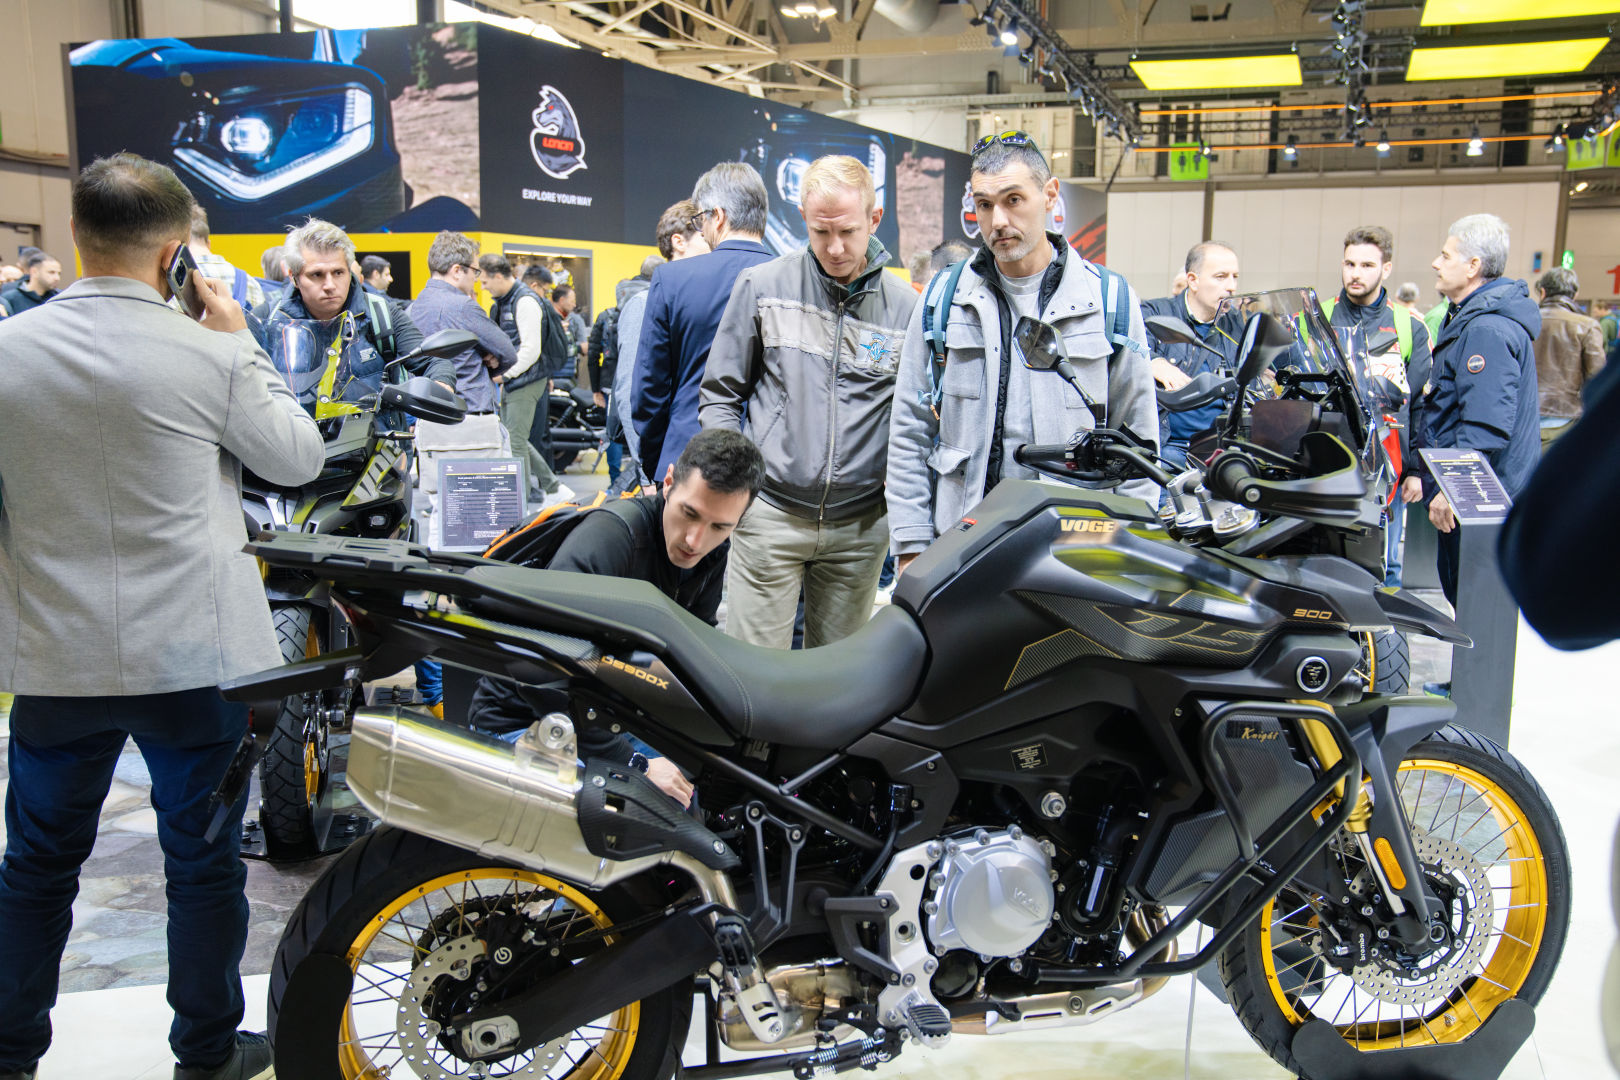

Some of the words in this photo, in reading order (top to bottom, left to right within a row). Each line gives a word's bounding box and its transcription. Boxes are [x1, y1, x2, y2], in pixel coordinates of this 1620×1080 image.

[522, 188, 557, 203] EXPLORE
[557, 193, 577, 205] YOUR
[577, 195, 593, 206] WAY
[1060, 519, 1115, 533] VOGE
[1293, 608, 1333, 620] 900
[601, 655, 669, 690] DS900X
[1241, 727, 1279, 743] Knight
[1358, 932, 1366, 961] brembo
